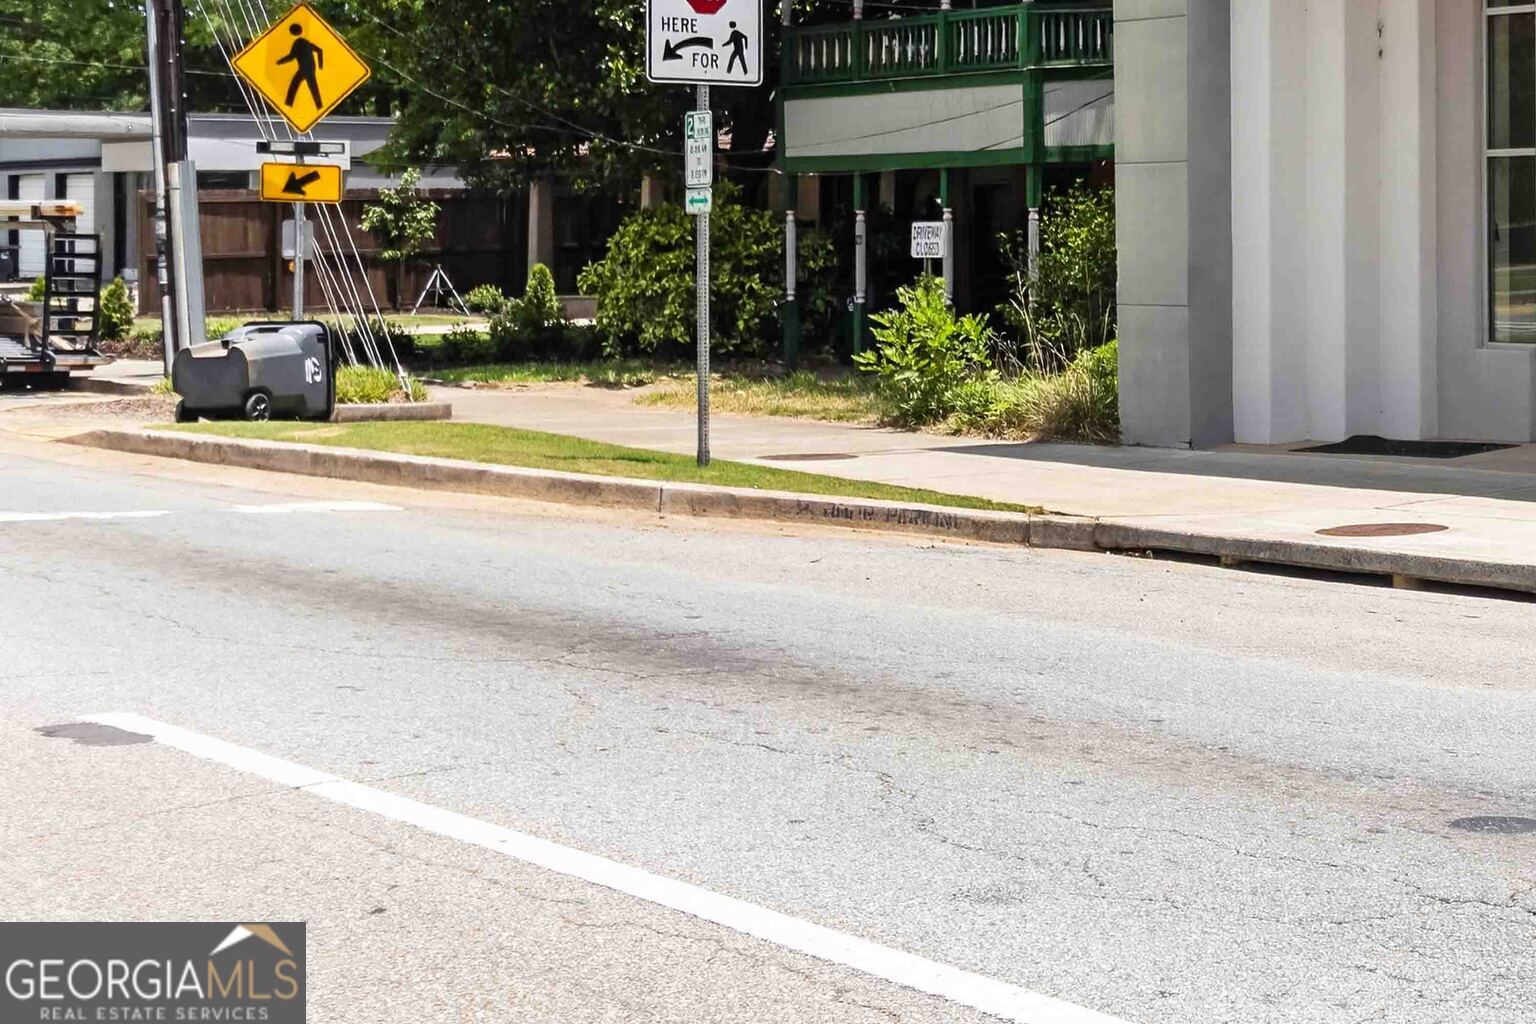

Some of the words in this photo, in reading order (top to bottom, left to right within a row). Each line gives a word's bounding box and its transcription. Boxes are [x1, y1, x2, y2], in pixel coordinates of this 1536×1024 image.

[661, 16, 698, 34] HERE
[692, 52, 719, 69] FOR
[913, 226, 942, 241] DRIVEWAY
[915, 241, 940, 256] CLOSED
